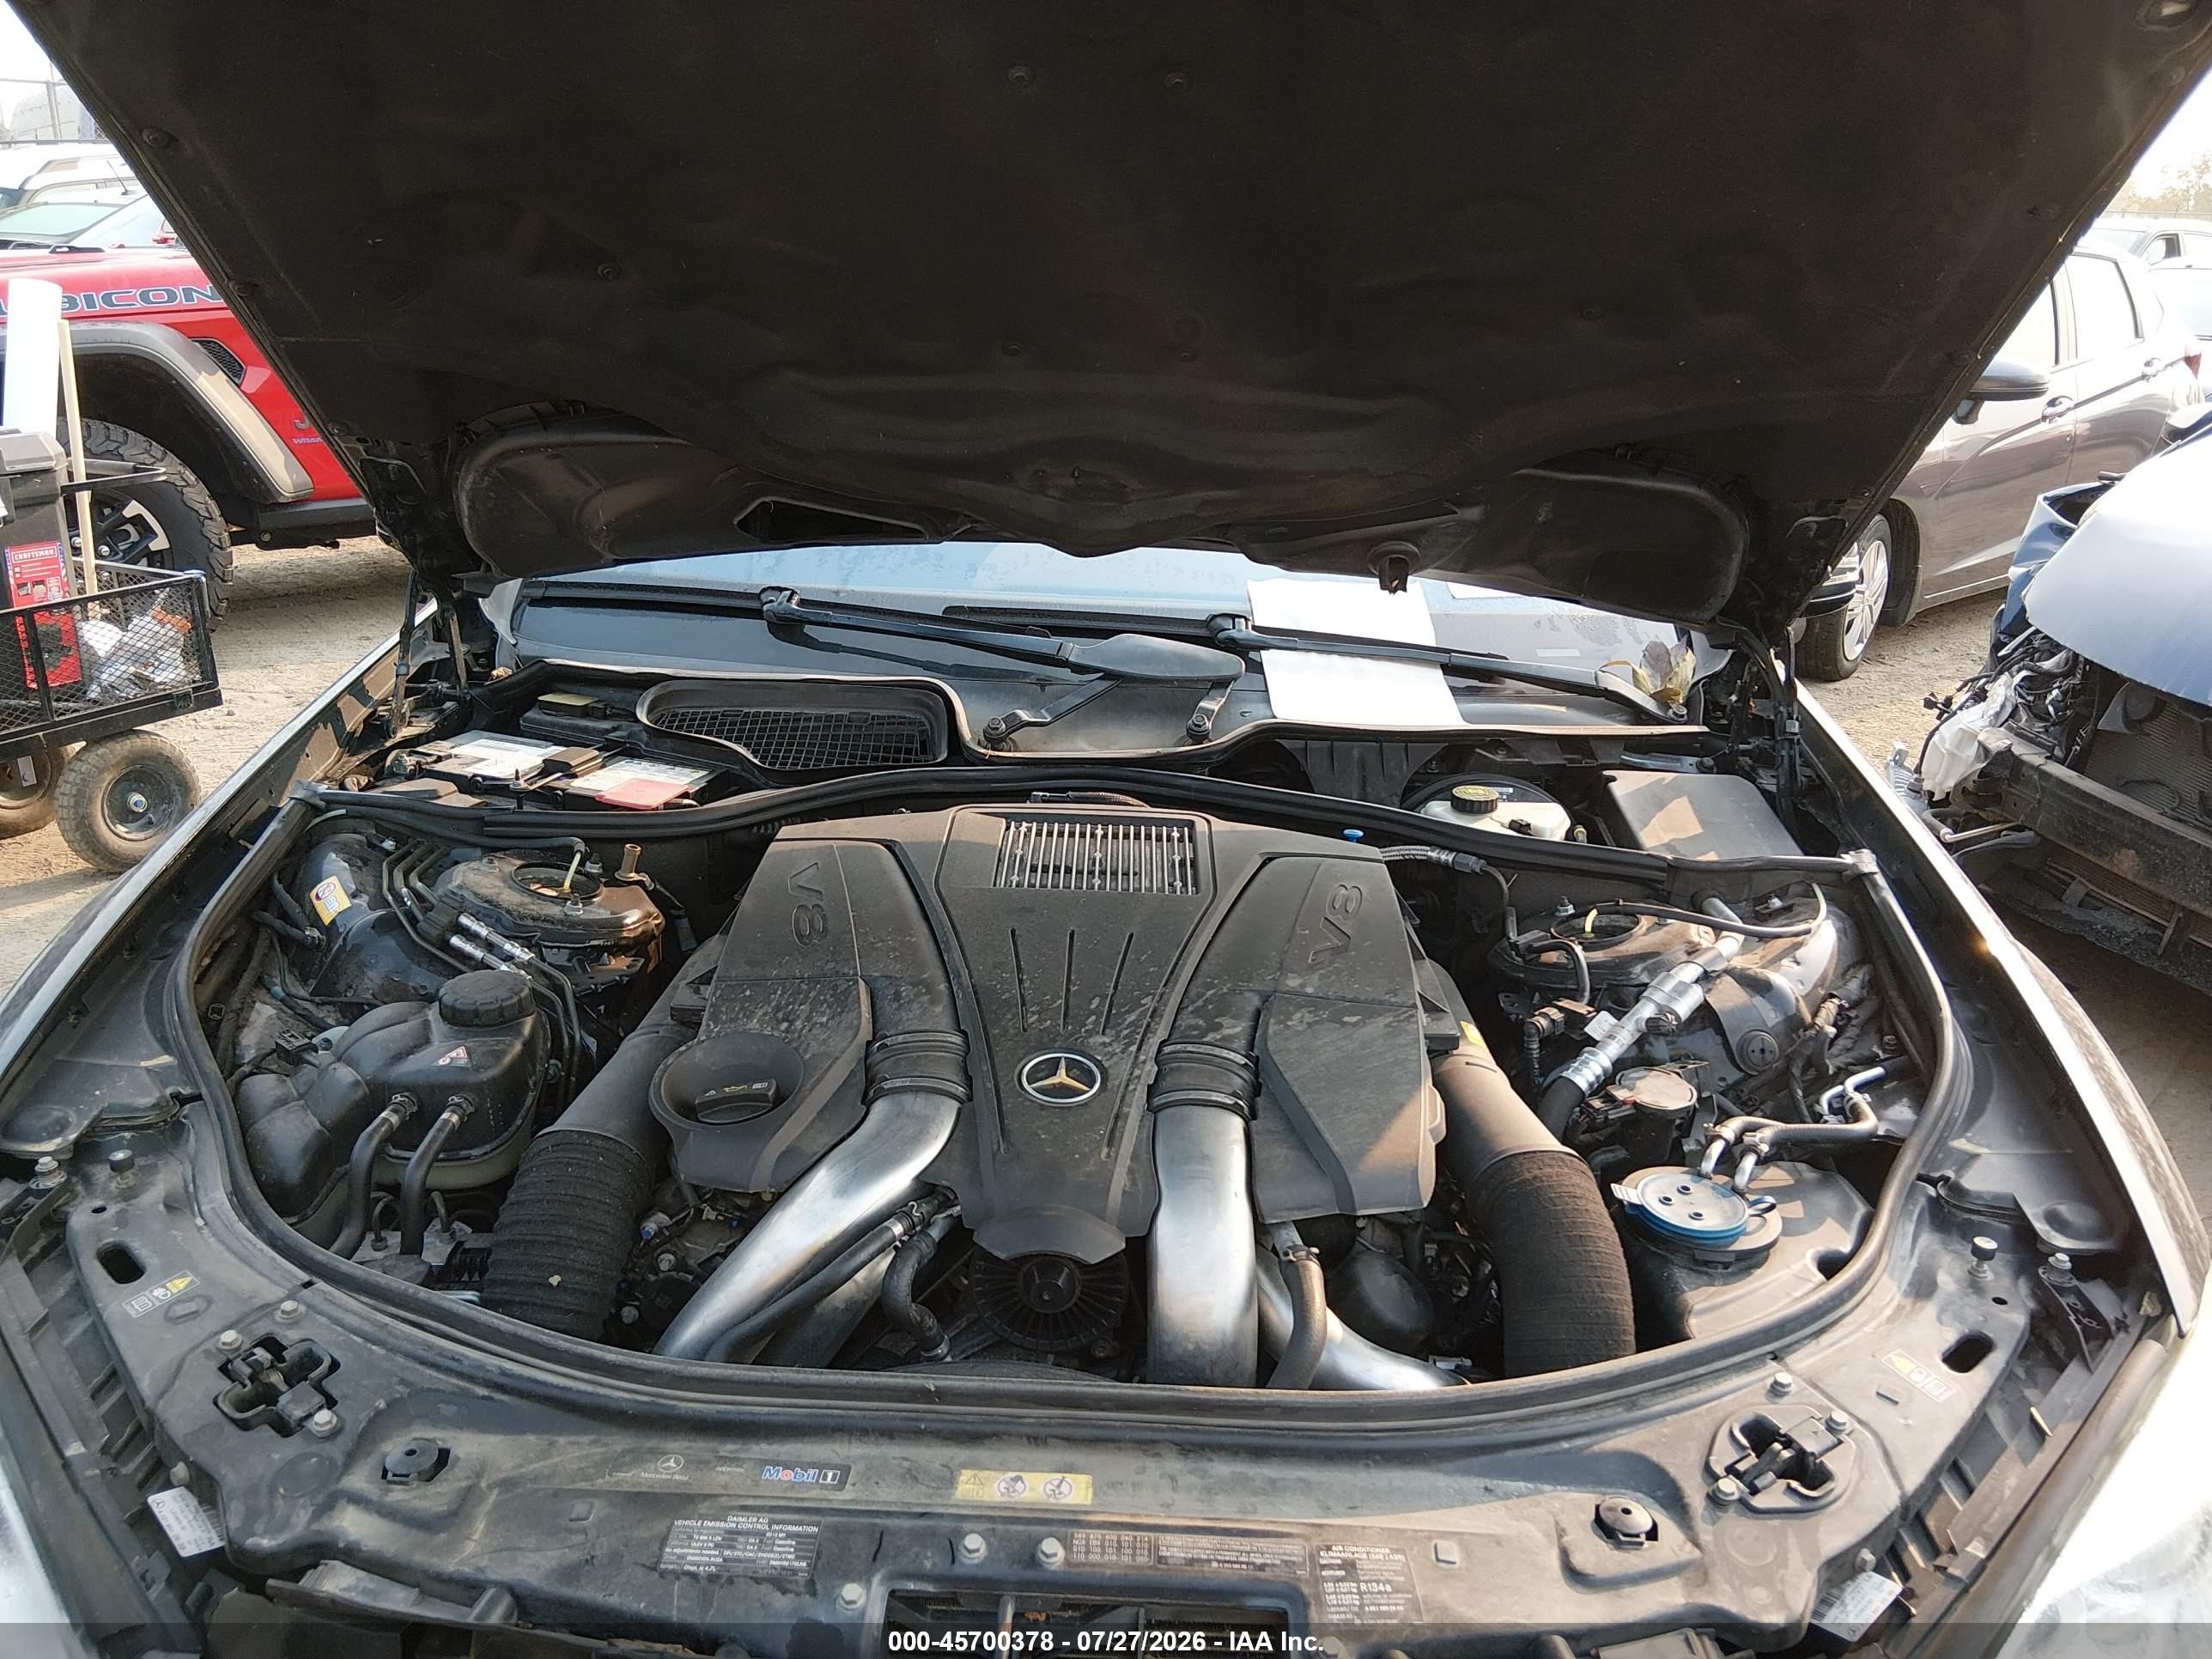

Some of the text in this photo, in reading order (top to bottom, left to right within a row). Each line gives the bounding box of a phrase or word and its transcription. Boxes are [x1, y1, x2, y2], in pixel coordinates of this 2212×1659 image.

[788, 861, 828, 947] V8
[1309, 884, 1362, 963] V8
[763, 1466, 818, 1482] Mobil
[771, 1524, 818, 1533] INFORMATION
[1344, 1546, 1390, 1554] CONDITIONER
[1359, 1582, 1392, 1592] R134a
